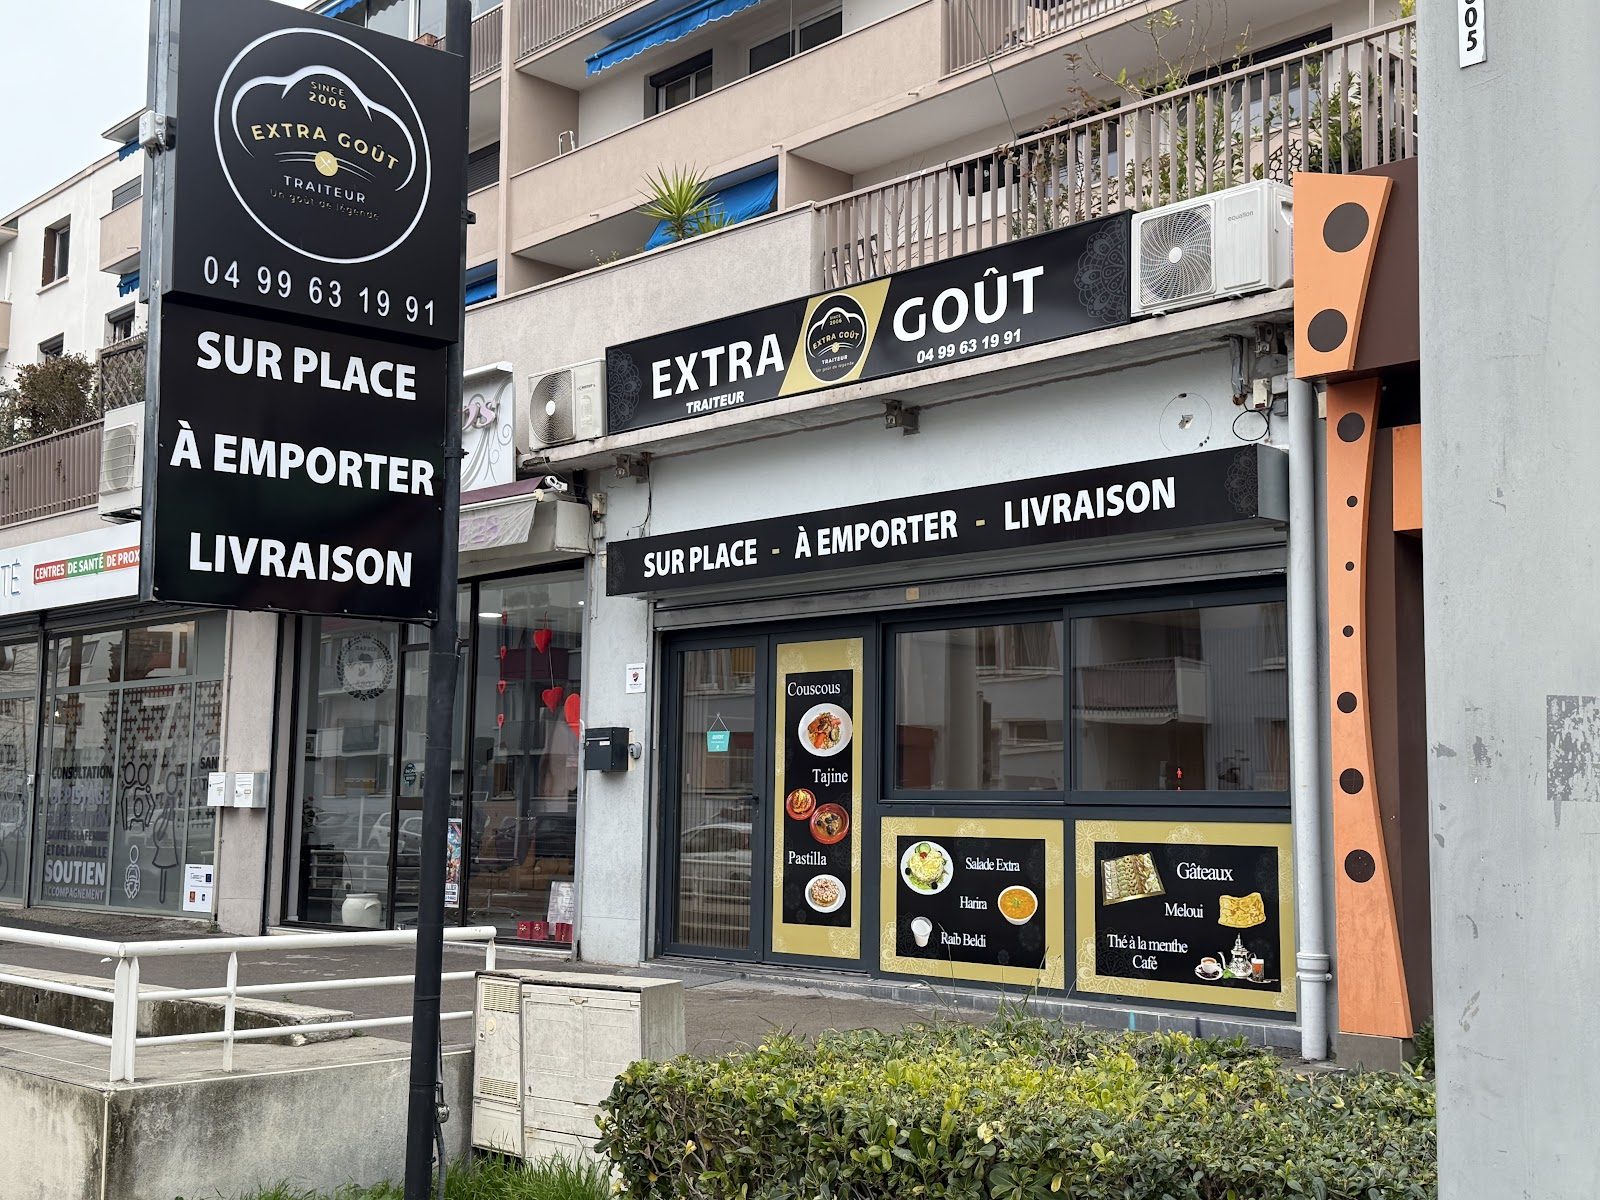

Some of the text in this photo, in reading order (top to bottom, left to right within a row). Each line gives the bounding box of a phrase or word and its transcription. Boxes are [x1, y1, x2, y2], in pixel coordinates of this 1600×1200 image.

[1464, 0, 1478, 51] 05
[311, 81, 345, 96] SINCE
[309, 91, 347, 110] 2006
[251, 123, 399, 170] EXTRA GOÛT
[284, 175, 366, 203] TRAITEUR
[204, 255, 434, 326] 04 99 63 19 91
[652, 265, 1044, 400] EXTRA GOÛT
[812, 331, 837, 350] EXTRA
[917, 328, 1021, 364] 04 99 63 19 91
[197, 331, 416, 400] SUR PLACE
[822, 354, 848, 365] TRAITEUR
[686, 390, 745, 414] TRAITEUR
[170, 419, 434, 496] À EMPORTER
[643, 549, 685, 578] SUR
[689, 538, 758, 573] PLACE
[794, 526, 812, 559] À
[817, 509, 958, 556] EMPORTER
[1004, 476, 1176, 531] LIVRAISON
[35, 563, 65, 580] CENTRES
[67, 562, 78, 574] DE
[79, 553, 104, 573] SANTÉ
[106, 555, 117, 568] DE
[189, 531, 413, 588] LIVRAISON
[787, 681, 841, 697] Couscous
[200, 756, 219, 770] SAN
[52, 766, 113, 780] CONSULTATION
[812, 768, 849, 787] Tajine
[46, 844, 55, 856] ET
[788, 851, 827, 866] Pastilla
[44, 859, 106, 887] SOUTIEN
[965, 857, 1020, 872] Salade Extra
[1176, 862, 1234, 881] Gâteaux
[960, 896, 988, 910] Harira
[1164, 902, 1204, 918] Meloui
[963, 933, 986, 948] Beldi
[1107, 934, 1188, 953] Thé à la menthe
[1132, 955, 1158, 970] Café
